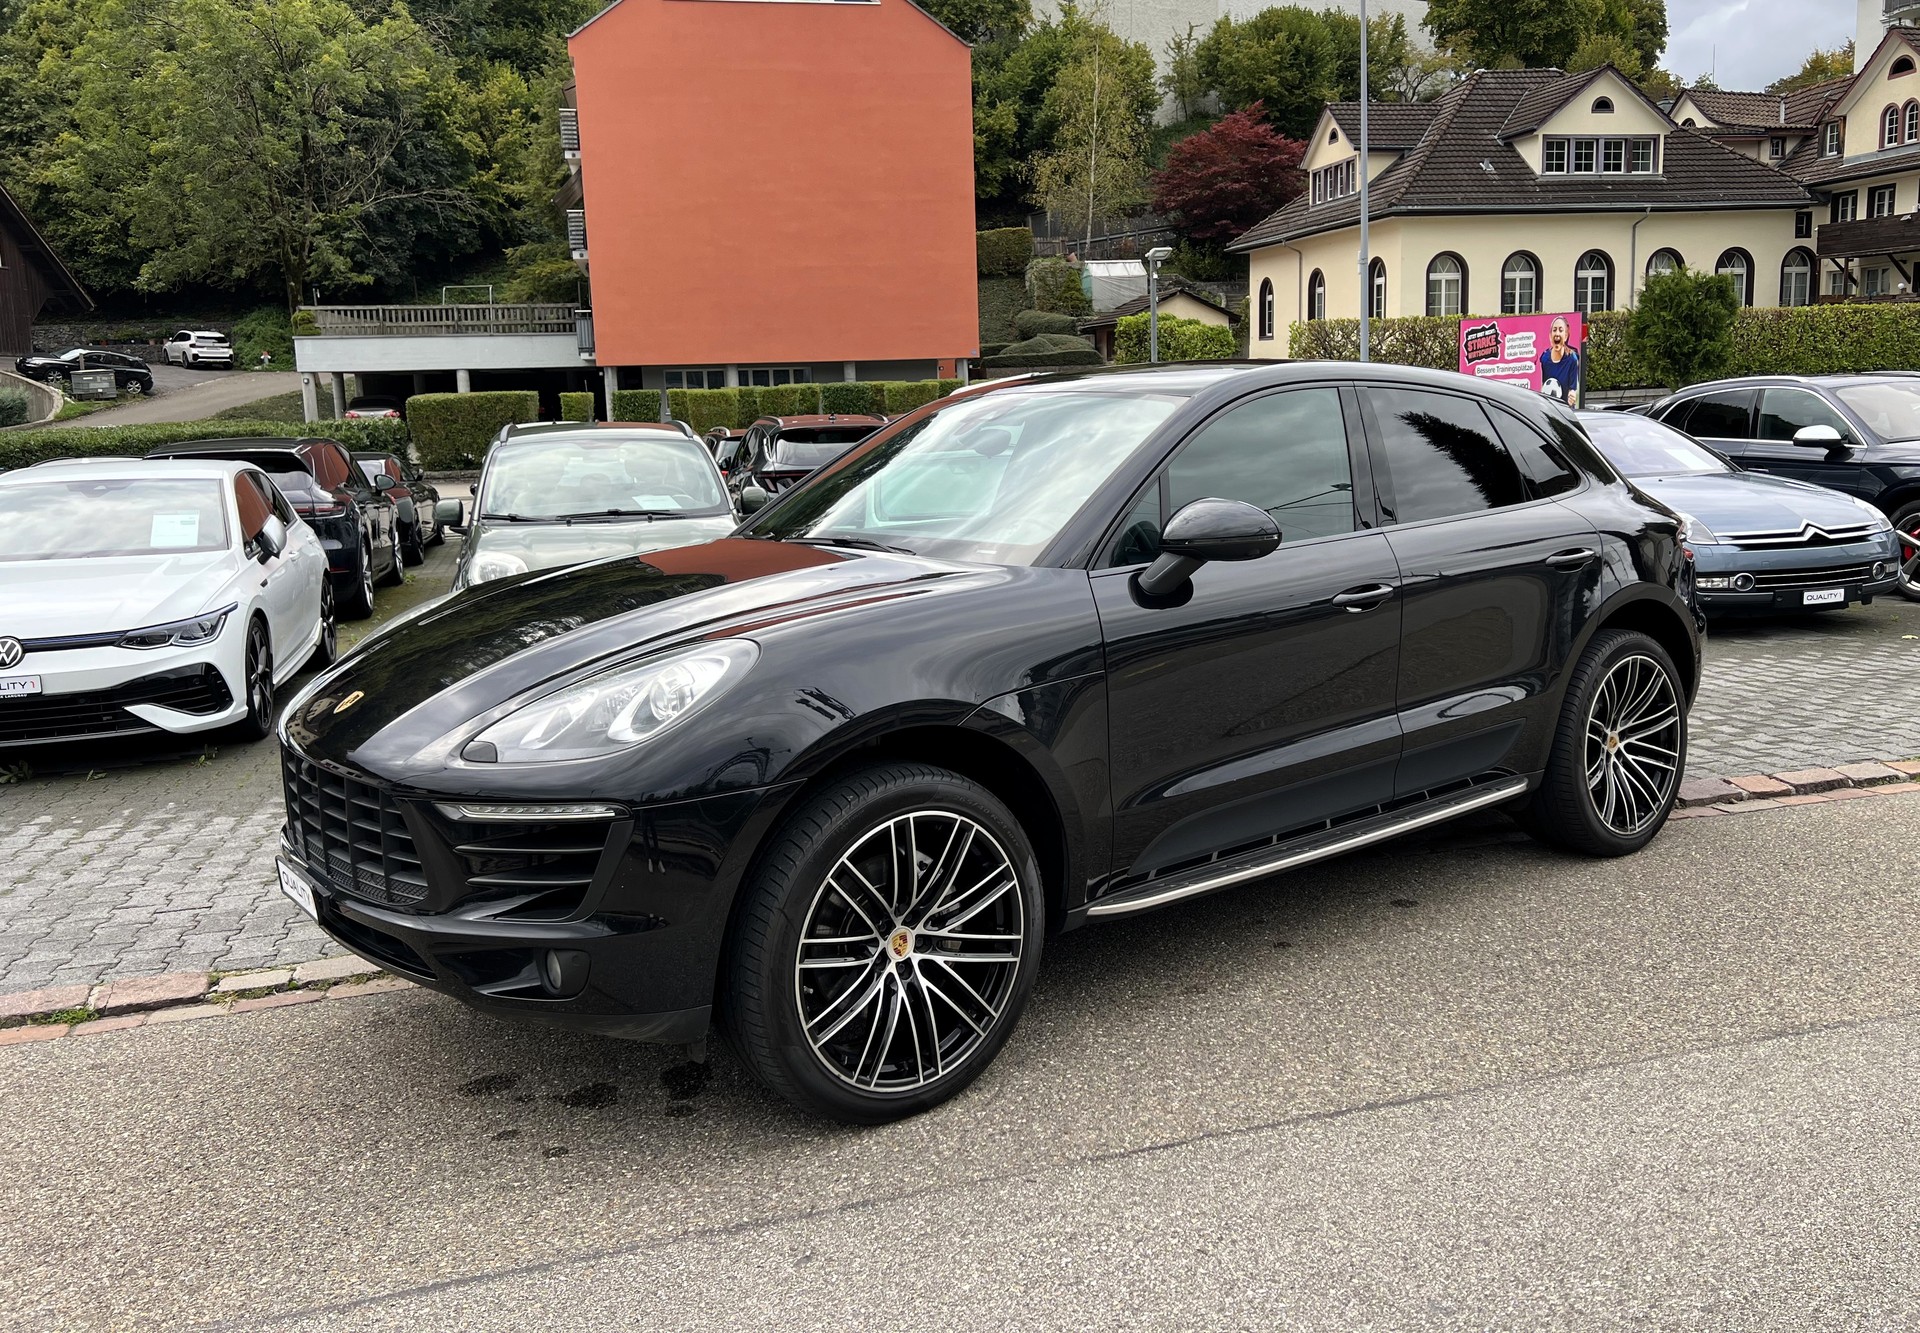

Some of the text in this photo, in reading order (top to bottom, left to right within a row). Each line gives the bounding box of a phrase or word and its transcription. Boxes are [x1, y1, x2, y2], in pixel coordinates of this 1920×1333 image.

[1467, 335, 1497, 351] STARKE
[1506, 334, 1533, 343] Unternehmen
[1476, 366, 1496, 374] Bessere
[1806, 592, 1838, 601] QUALITY
[0, 681, 27, 691] LITY
